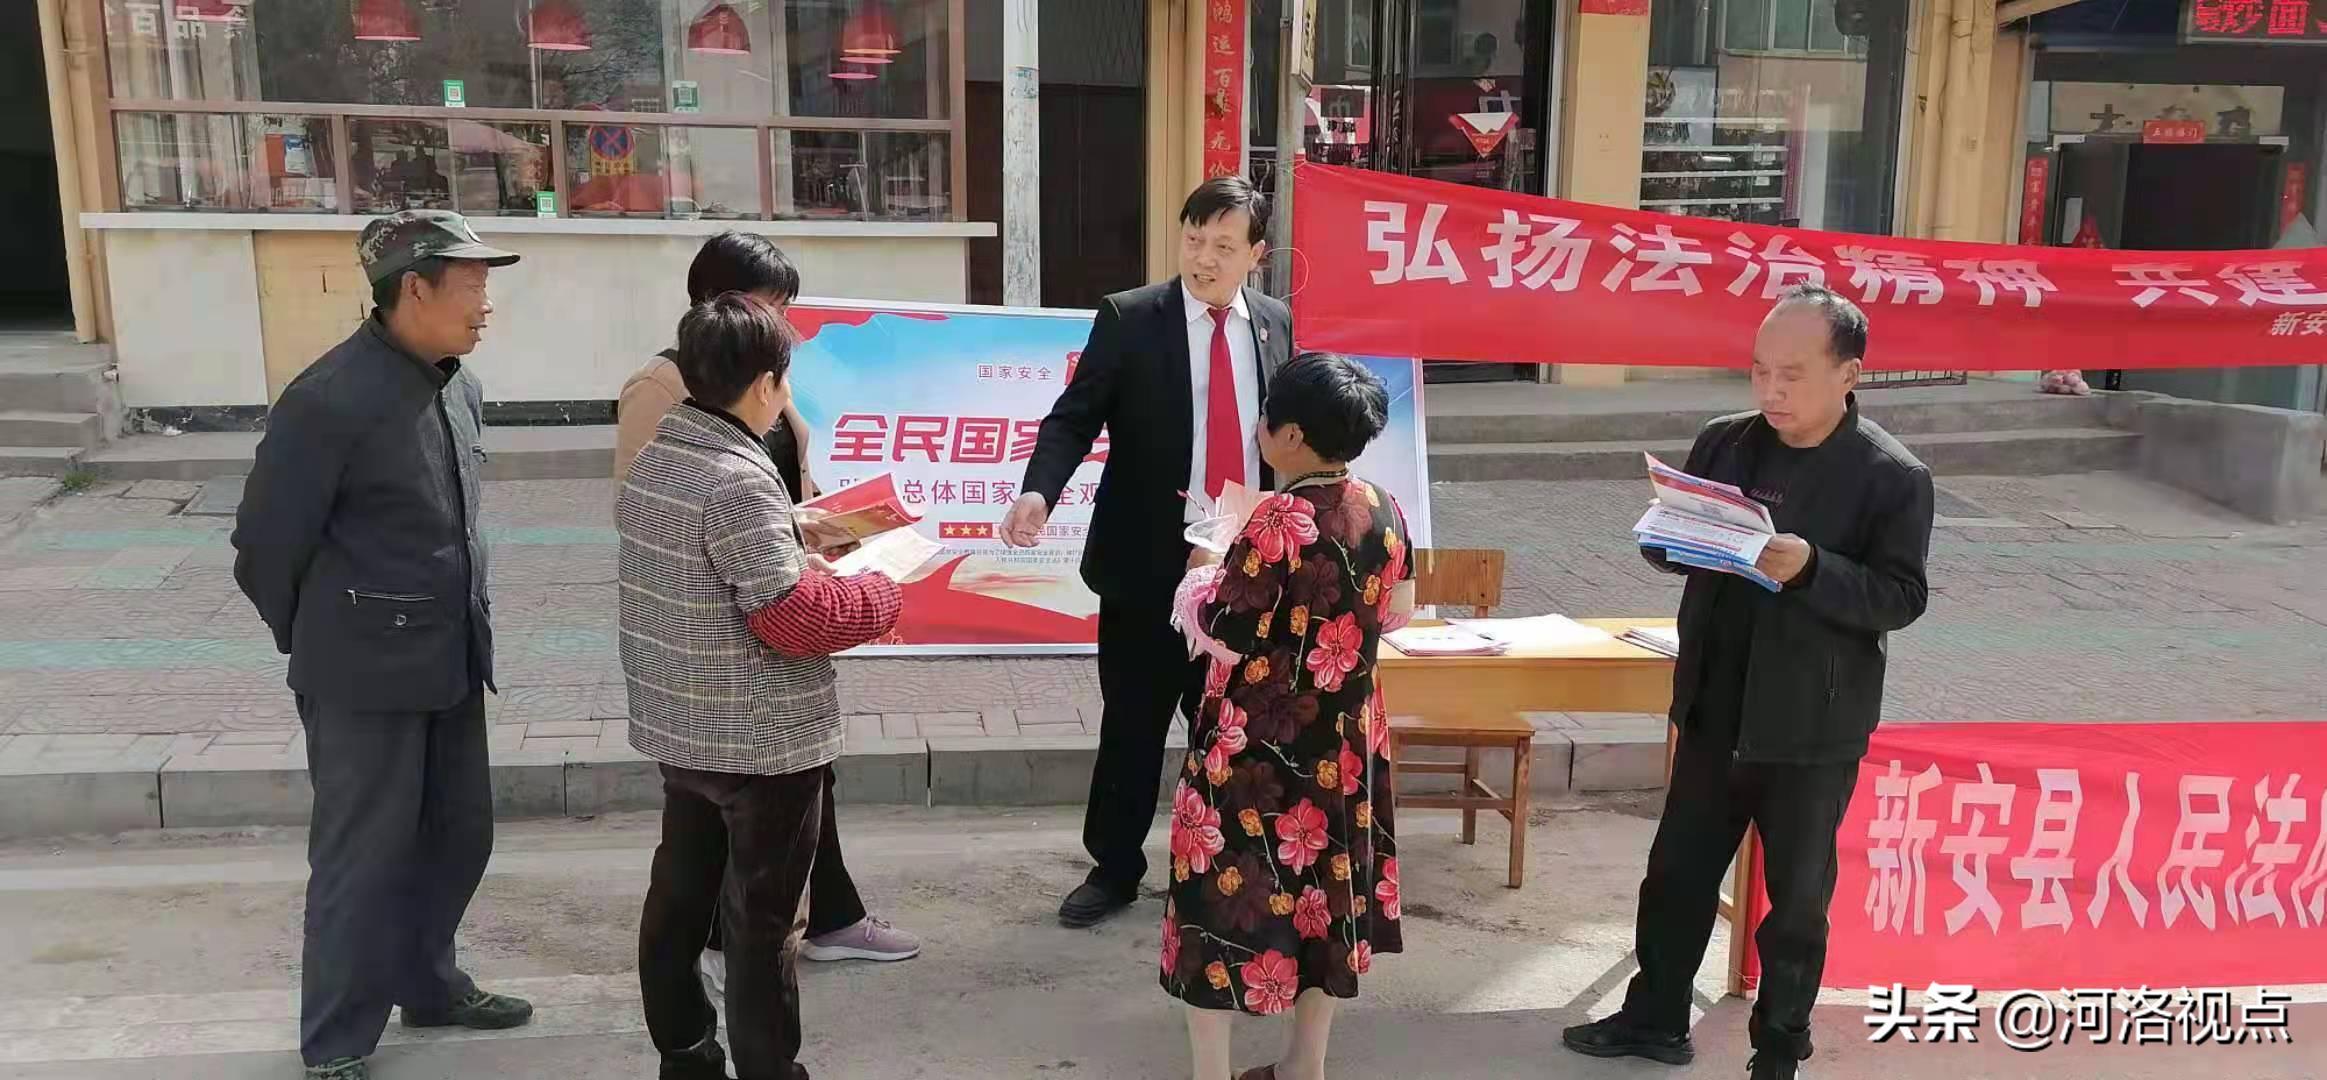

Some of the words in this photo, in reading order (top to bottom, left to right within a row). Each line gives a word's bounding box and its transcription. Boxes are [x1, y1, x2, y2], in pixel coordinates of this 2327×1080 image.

[1364, 200, 2059, 308] 弘扬法治精神
[978, 365, 1052, 381] 国家安全
[830, 414, 1108, 464] 全民国
